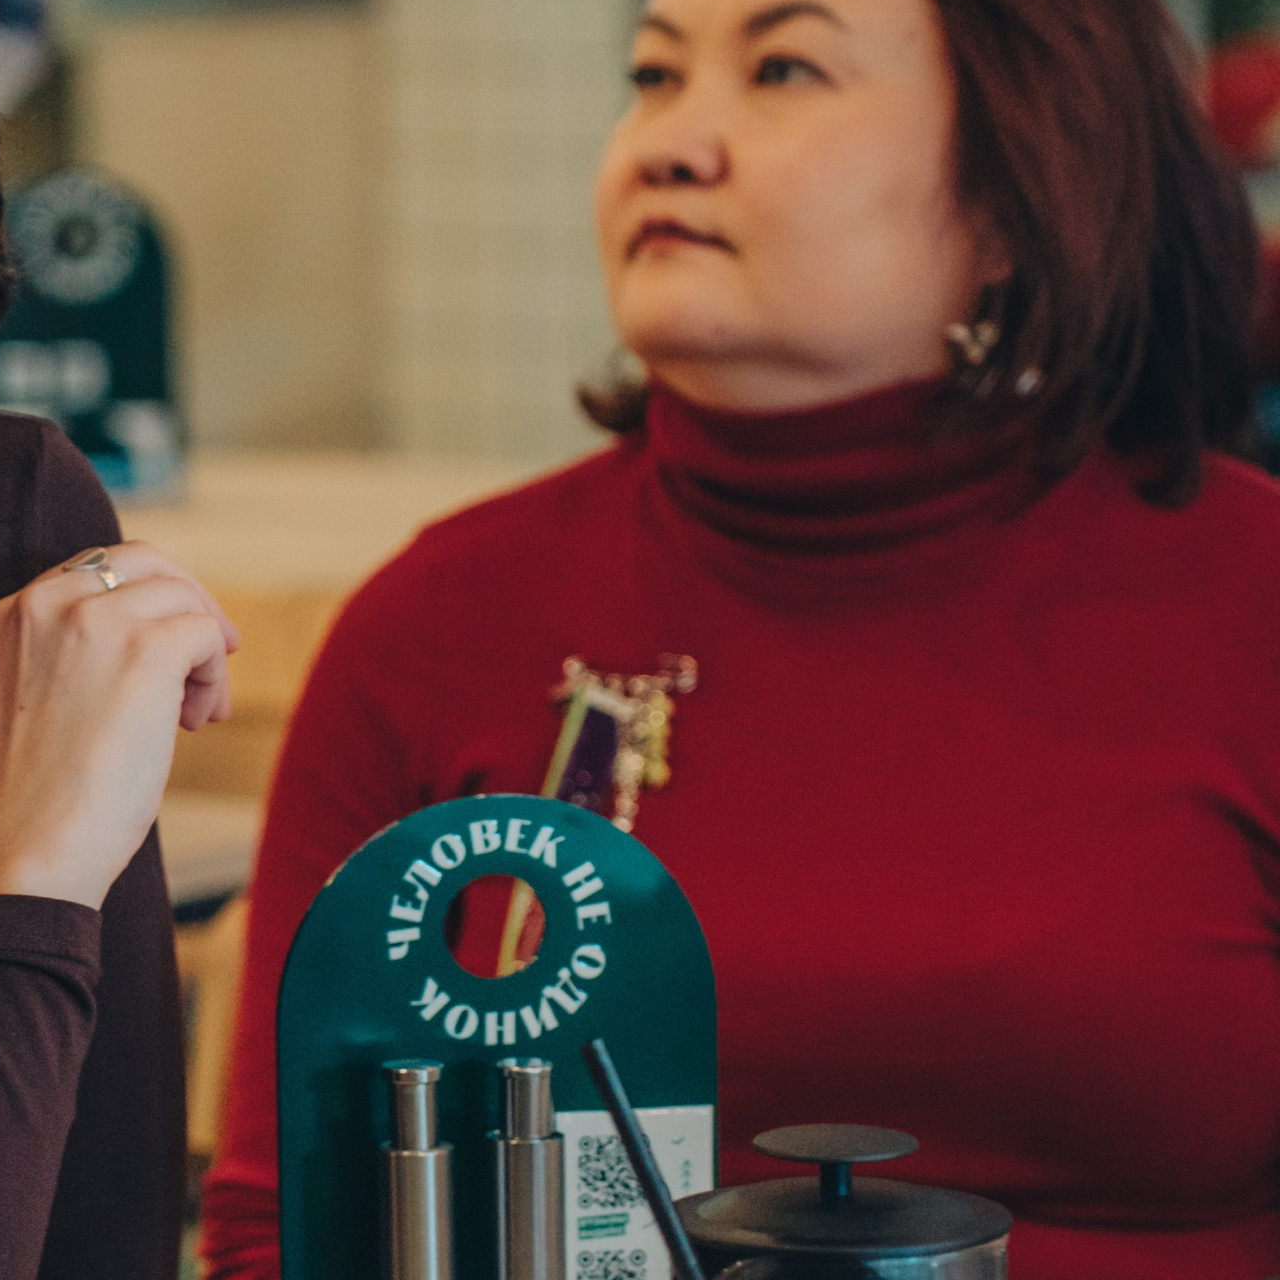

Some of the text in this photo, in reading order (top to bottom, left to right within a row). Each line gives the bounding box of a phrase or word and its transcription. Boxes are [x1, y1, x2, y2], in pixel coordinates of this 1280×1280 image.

[386, 818, 612, 1046] ЧЕЛОВЕК НЕ ОДИНОК
